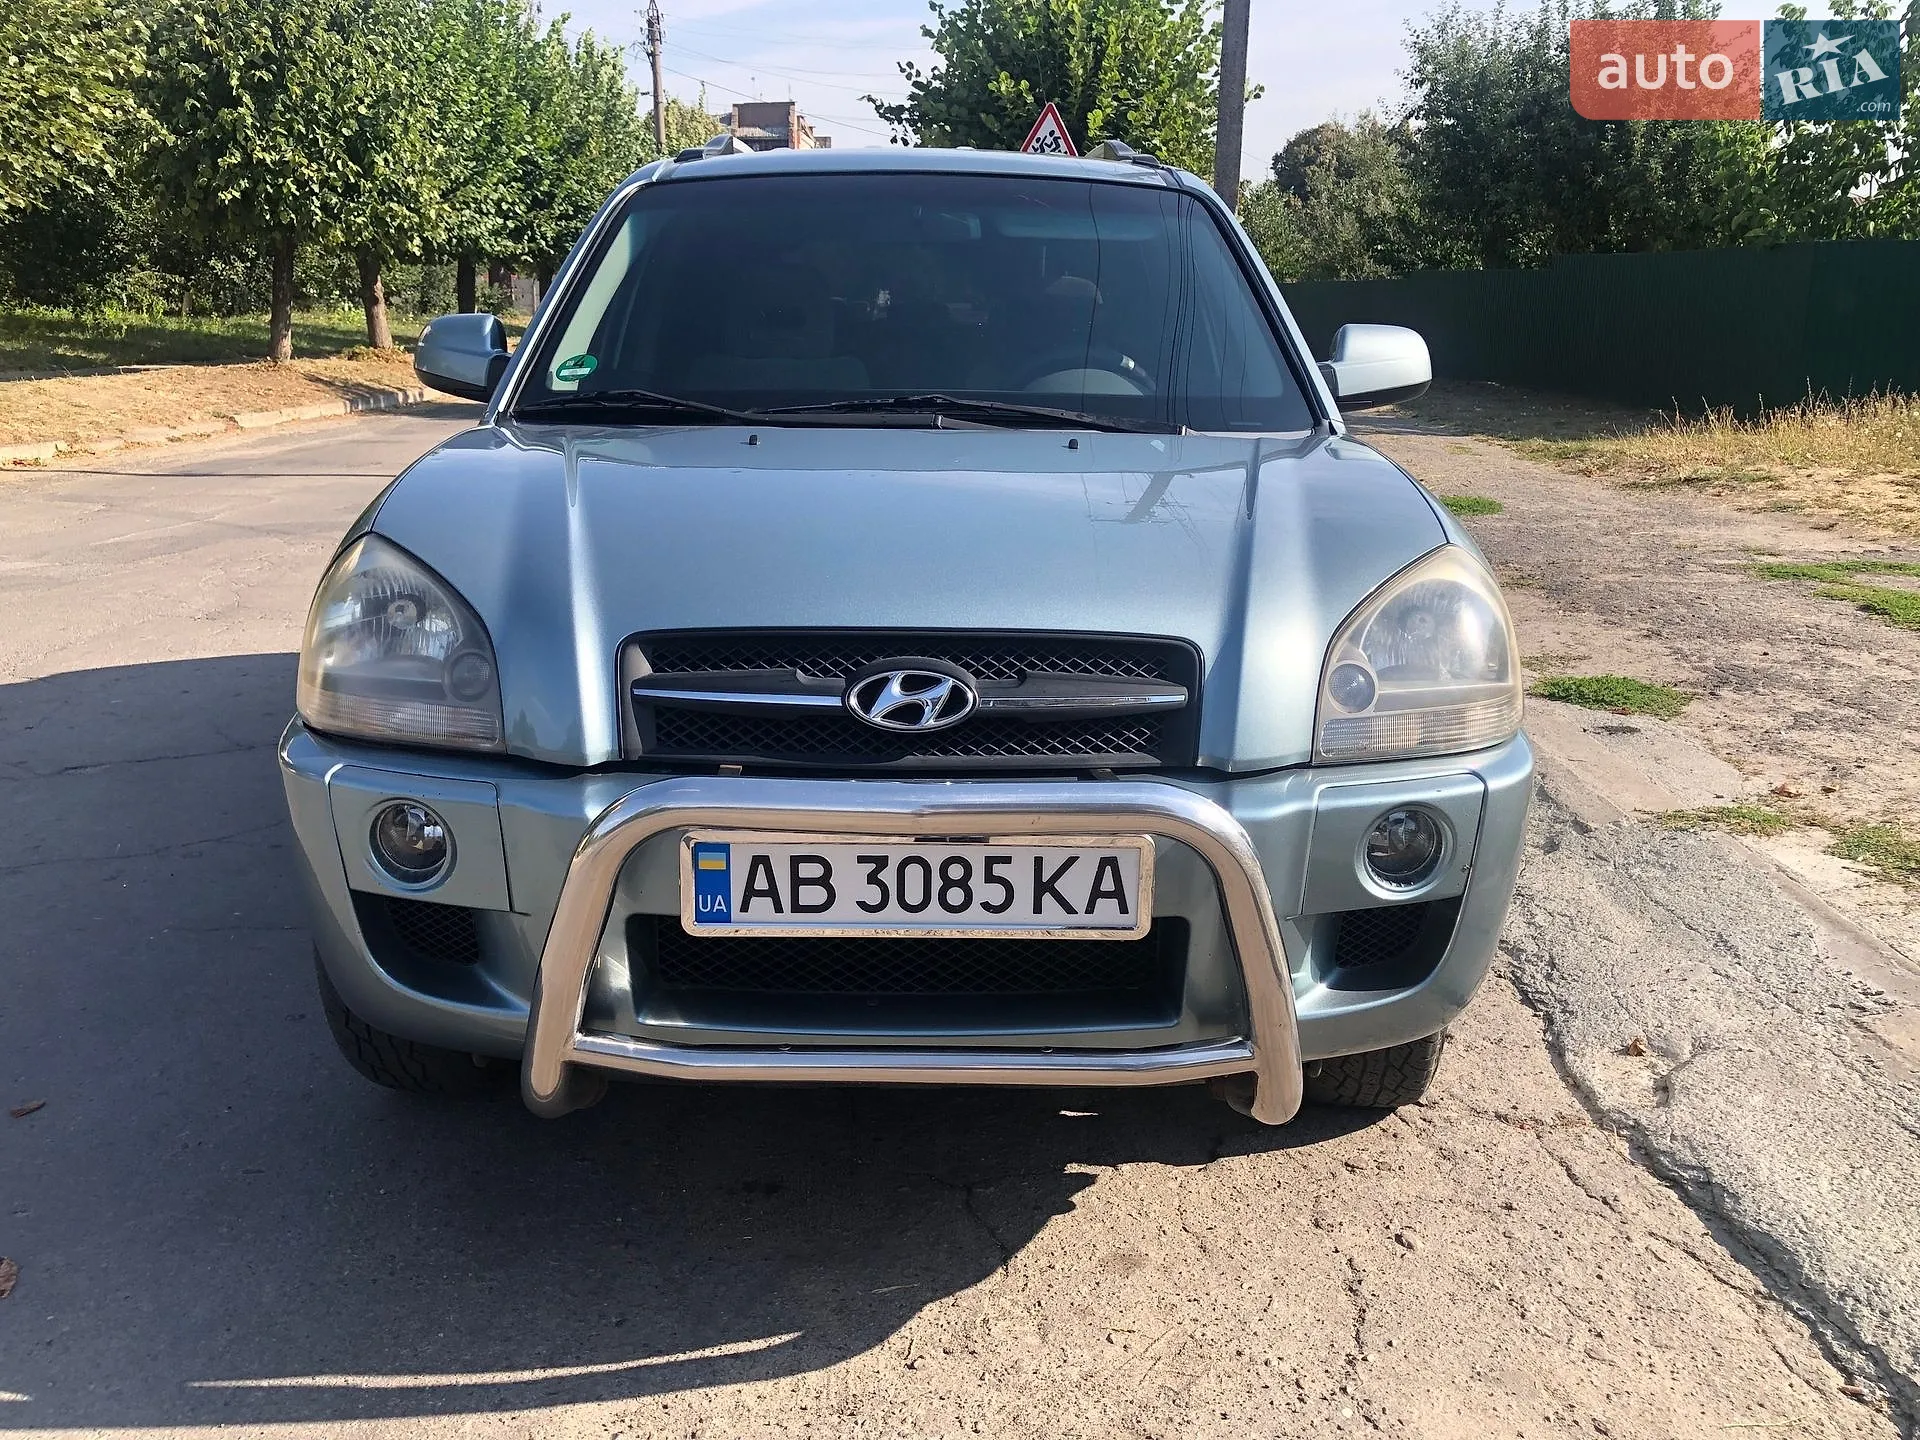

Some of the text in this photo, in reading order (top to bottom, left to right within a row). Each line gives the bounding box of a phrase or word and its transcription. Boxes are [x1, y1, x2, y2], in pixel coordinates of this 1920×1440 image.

[698, 894, 727, 913] UA
[739, 854, 1130, 915] AB 3085 KA
